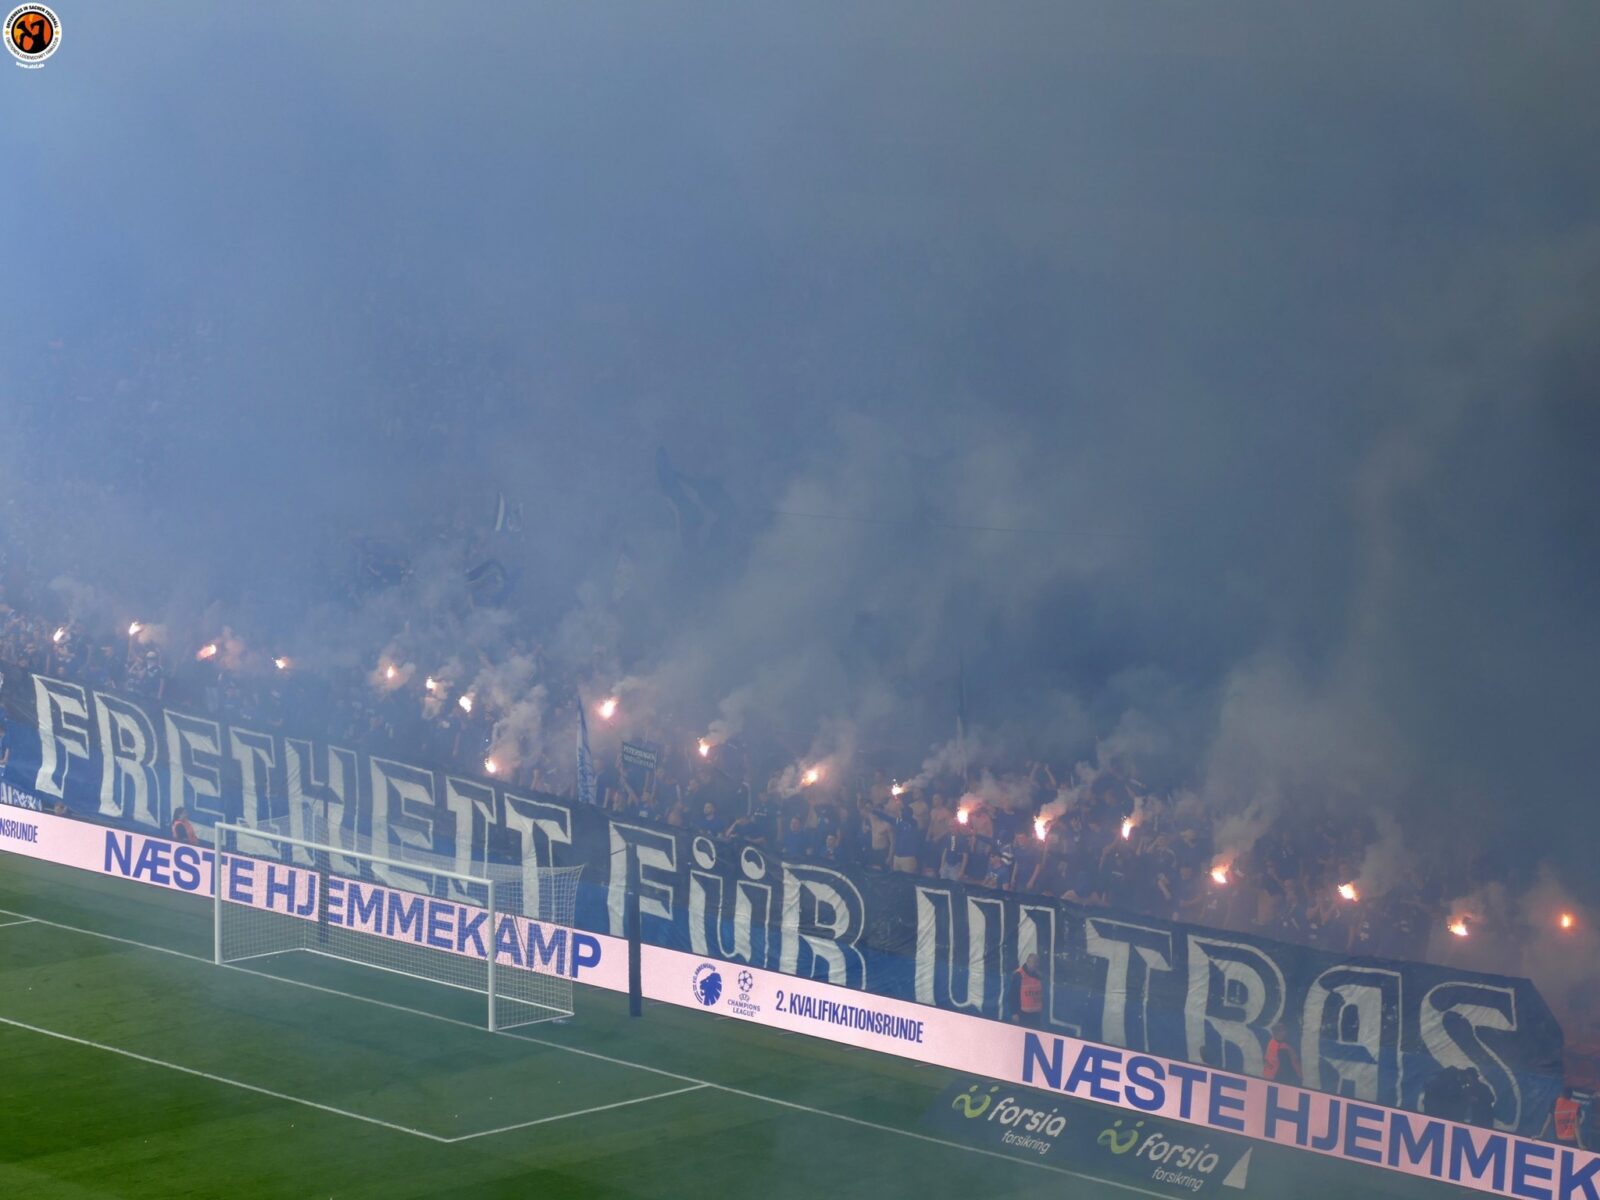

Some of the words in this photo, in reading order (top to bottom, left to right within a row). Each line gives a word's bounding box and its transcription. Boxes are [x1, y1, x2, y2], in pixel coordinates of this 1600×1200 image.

[104, 831, 254, 903] NÆSTE
[267, 866, 601, 978] HJEMMEKAMP
[728, 999, 760, 1011] CHAMPIONS
[733, 1007, 755, 1017] LEAGUE
[776, 990, 787, 1011] 2.
[790, 993, 923, 1043] KVALIFIKATIONSRUNDE
[914, 887, 1521, 1131] ULTRAS
[988, 1097, 1066, 1137] forsia
[1021, 1032, 1247, 1131] NÆSTE
[1264, 1085, 1600, 1200] HJEMMEK
[1001, 1130, 1051, 1154] forsikring
[1136, 1133, 1219, 1174] forsia
[1152, 1166, 1204, 1192] forsikring
